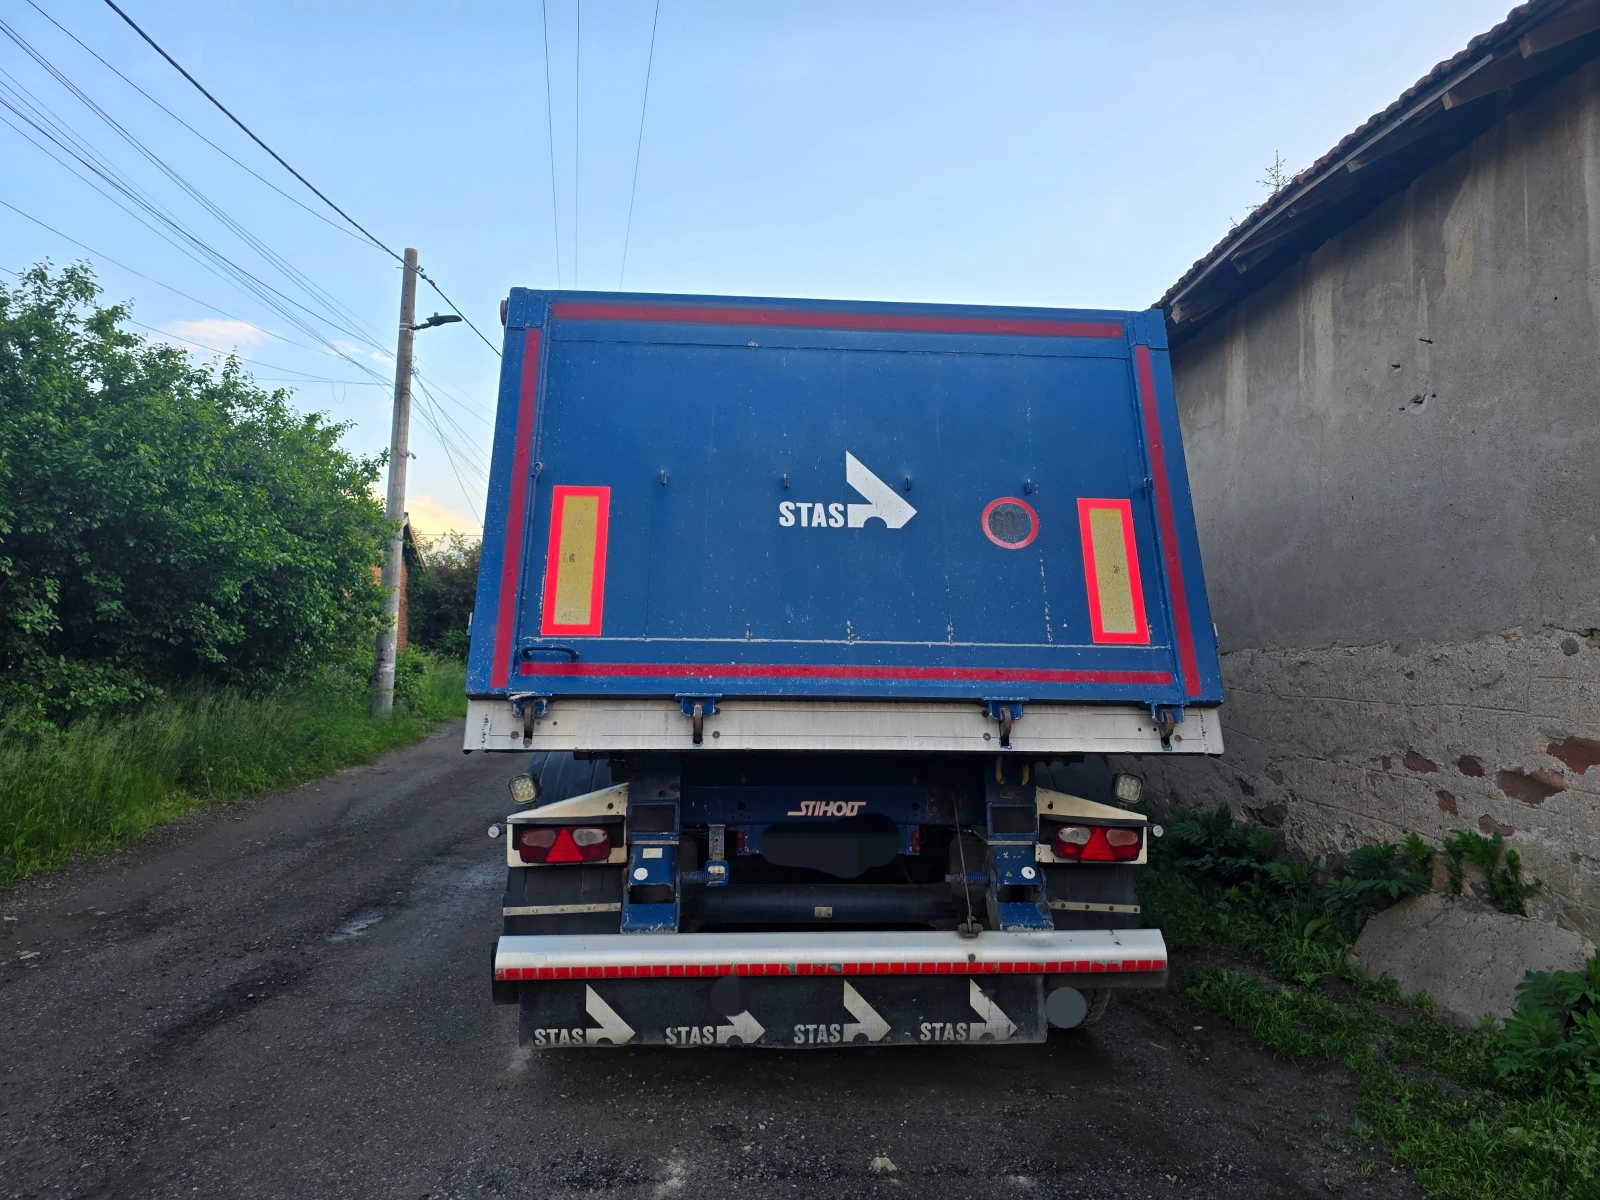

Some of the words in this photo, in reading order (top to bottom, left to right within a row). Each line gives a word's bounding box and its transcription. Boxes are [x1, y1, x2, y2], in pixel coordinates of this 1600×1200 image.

[778, 501, 845, 528] STAS
[534, 1028, 584, 1046] STAS
[665, 1025, 714, 1045] STAS
[793, 1023, 841, 1044] STAS
[919, 1022, 967, 1041] STAS
